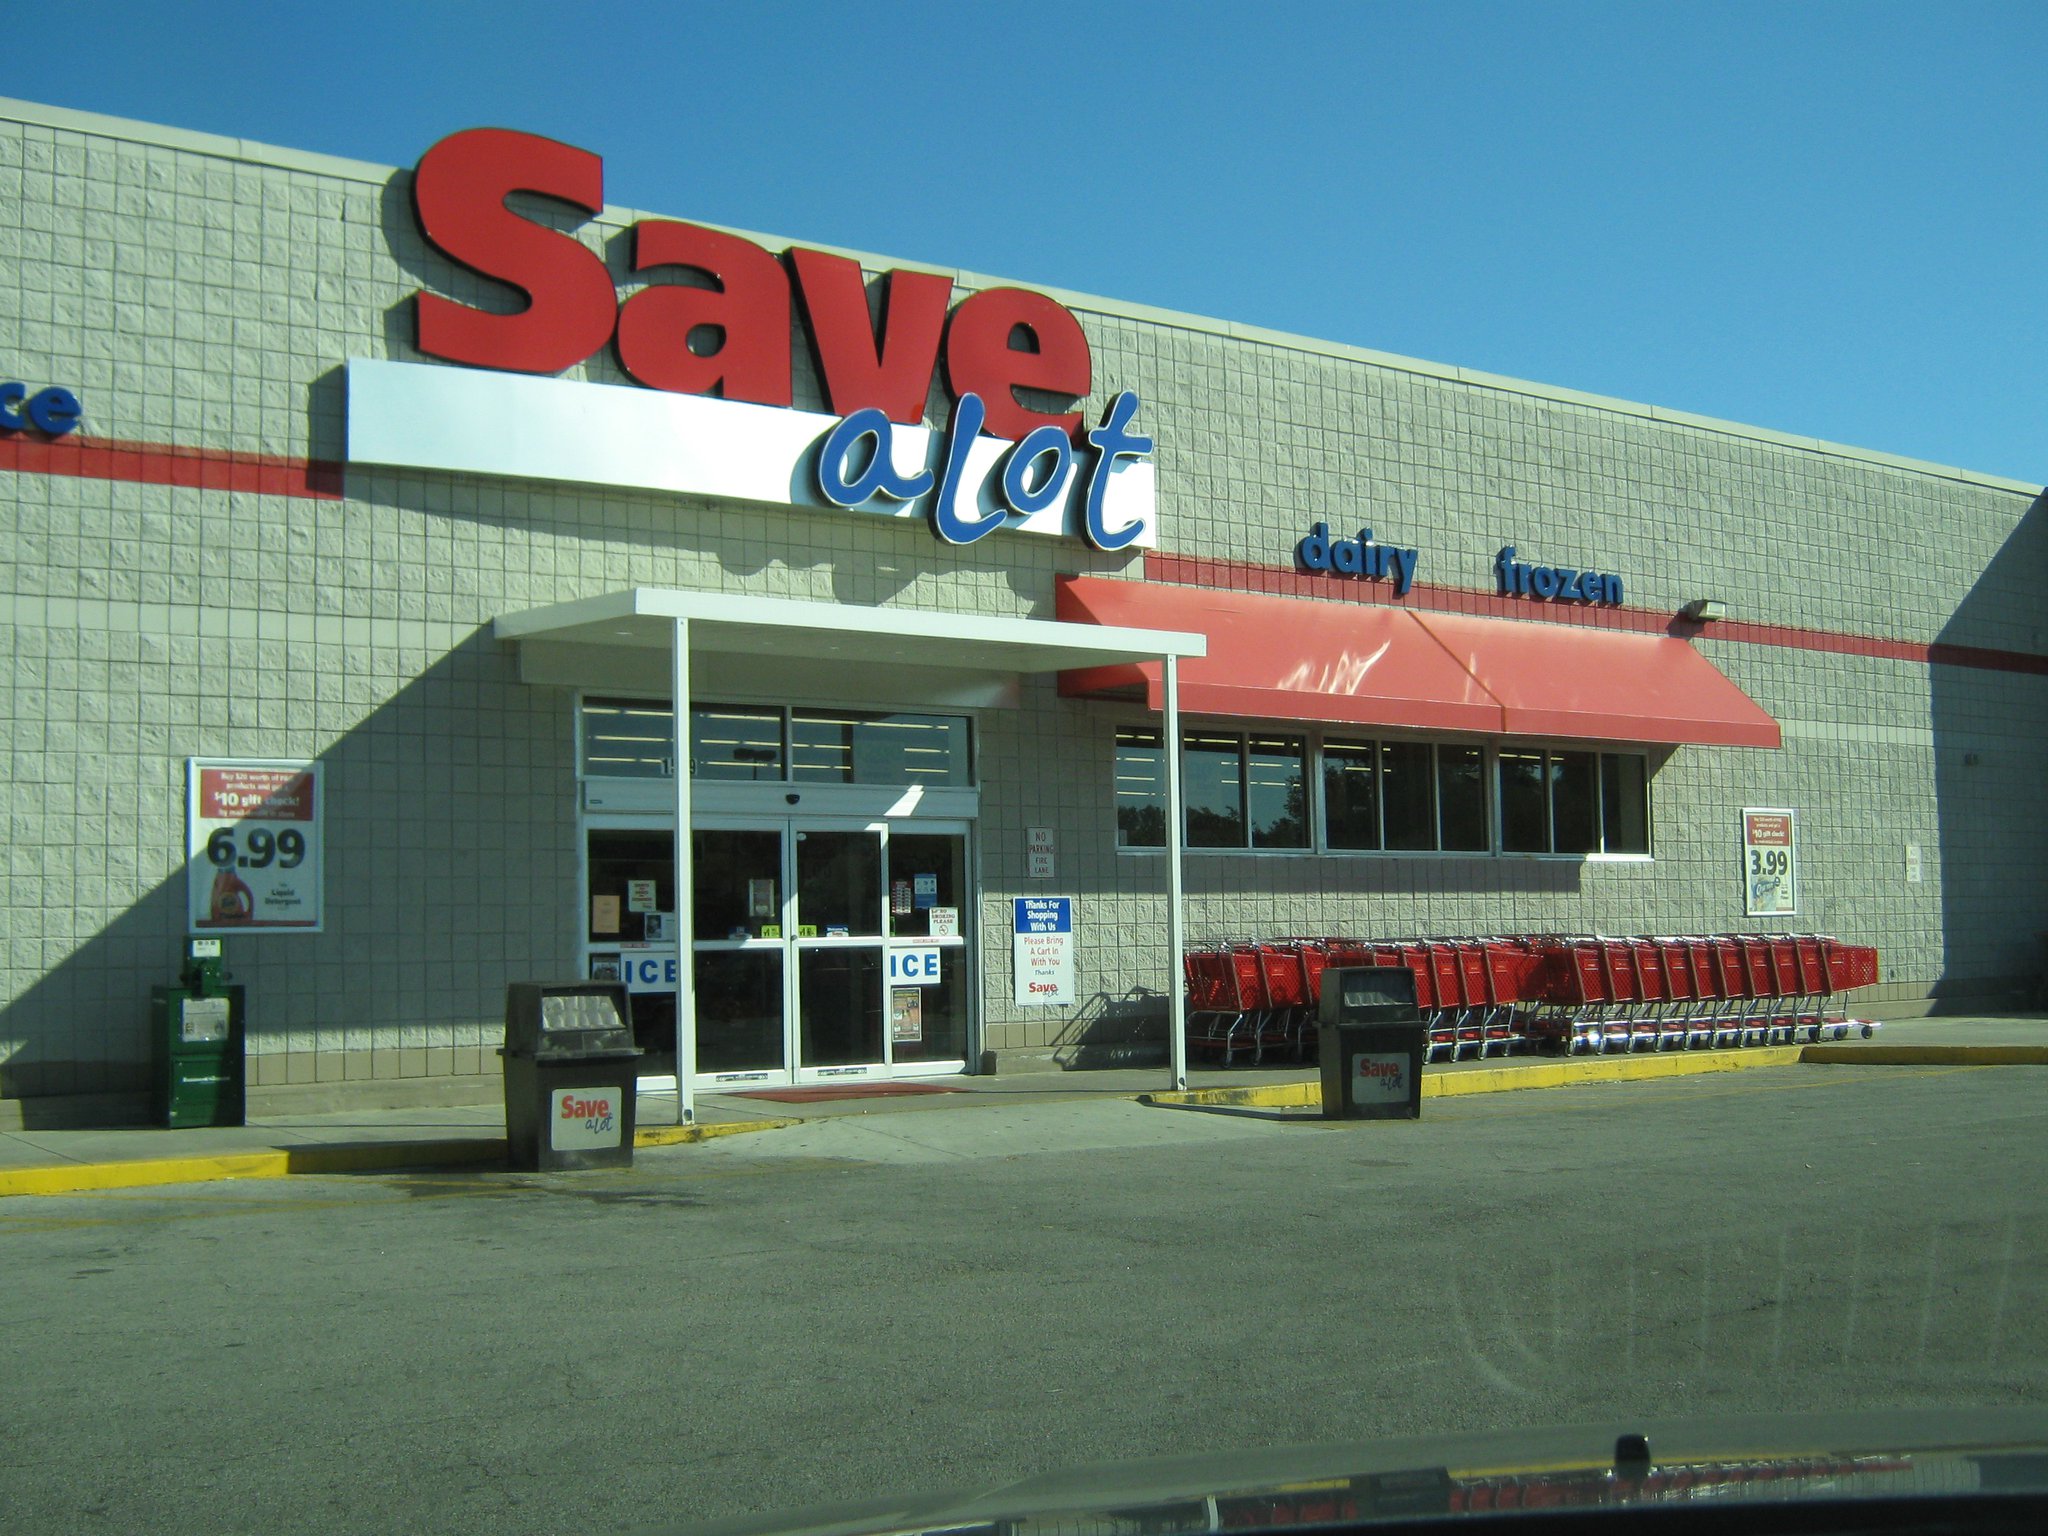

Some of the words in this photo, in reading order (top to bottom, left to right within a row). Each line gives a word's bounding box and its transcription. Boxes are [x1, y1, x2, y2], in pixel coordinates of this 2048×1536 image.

[414, 126, 1091, 441] Save
[1294, 521, 1418, 599] dairy
[1496, 544, 1624, 605] frozen
[214, 791, 239, 807] $10
[241, 795, 262, 807] gift
[1035, 832, 1046, 842] NO
[207, 827, 305, 868] 6.99
[1029, 844, 1055, 854] PARKING
[1751, 850, 1787, 875] 3.99
[1025, 900, 1048, 909] Thanks
[1049, 901, 1060, 909] For
[1027, 910, 1058, 921] Shopping
[1031, 922, 1047, 931] With
[1047, 922, 1056, 931] Us
[1024, 937, 1045, 945] Please
[1046, 936, 1064, 946] Bring
[1030, 947, 1036, 955] A
[1037, 947, 1051, 955] Cart
[1052, 947, 1059, 955] In
[890, 954, 938, 977] ICE
[1031, 957, 1047, 966] With
[1048, 958, 1060, 966] You
[625, 959, 676, 984] ICE
[1029, 982, 1057, 993] Save
[1360, 1058, 1399, 1077] Save
[561, 1095, 609, 1119] Save
